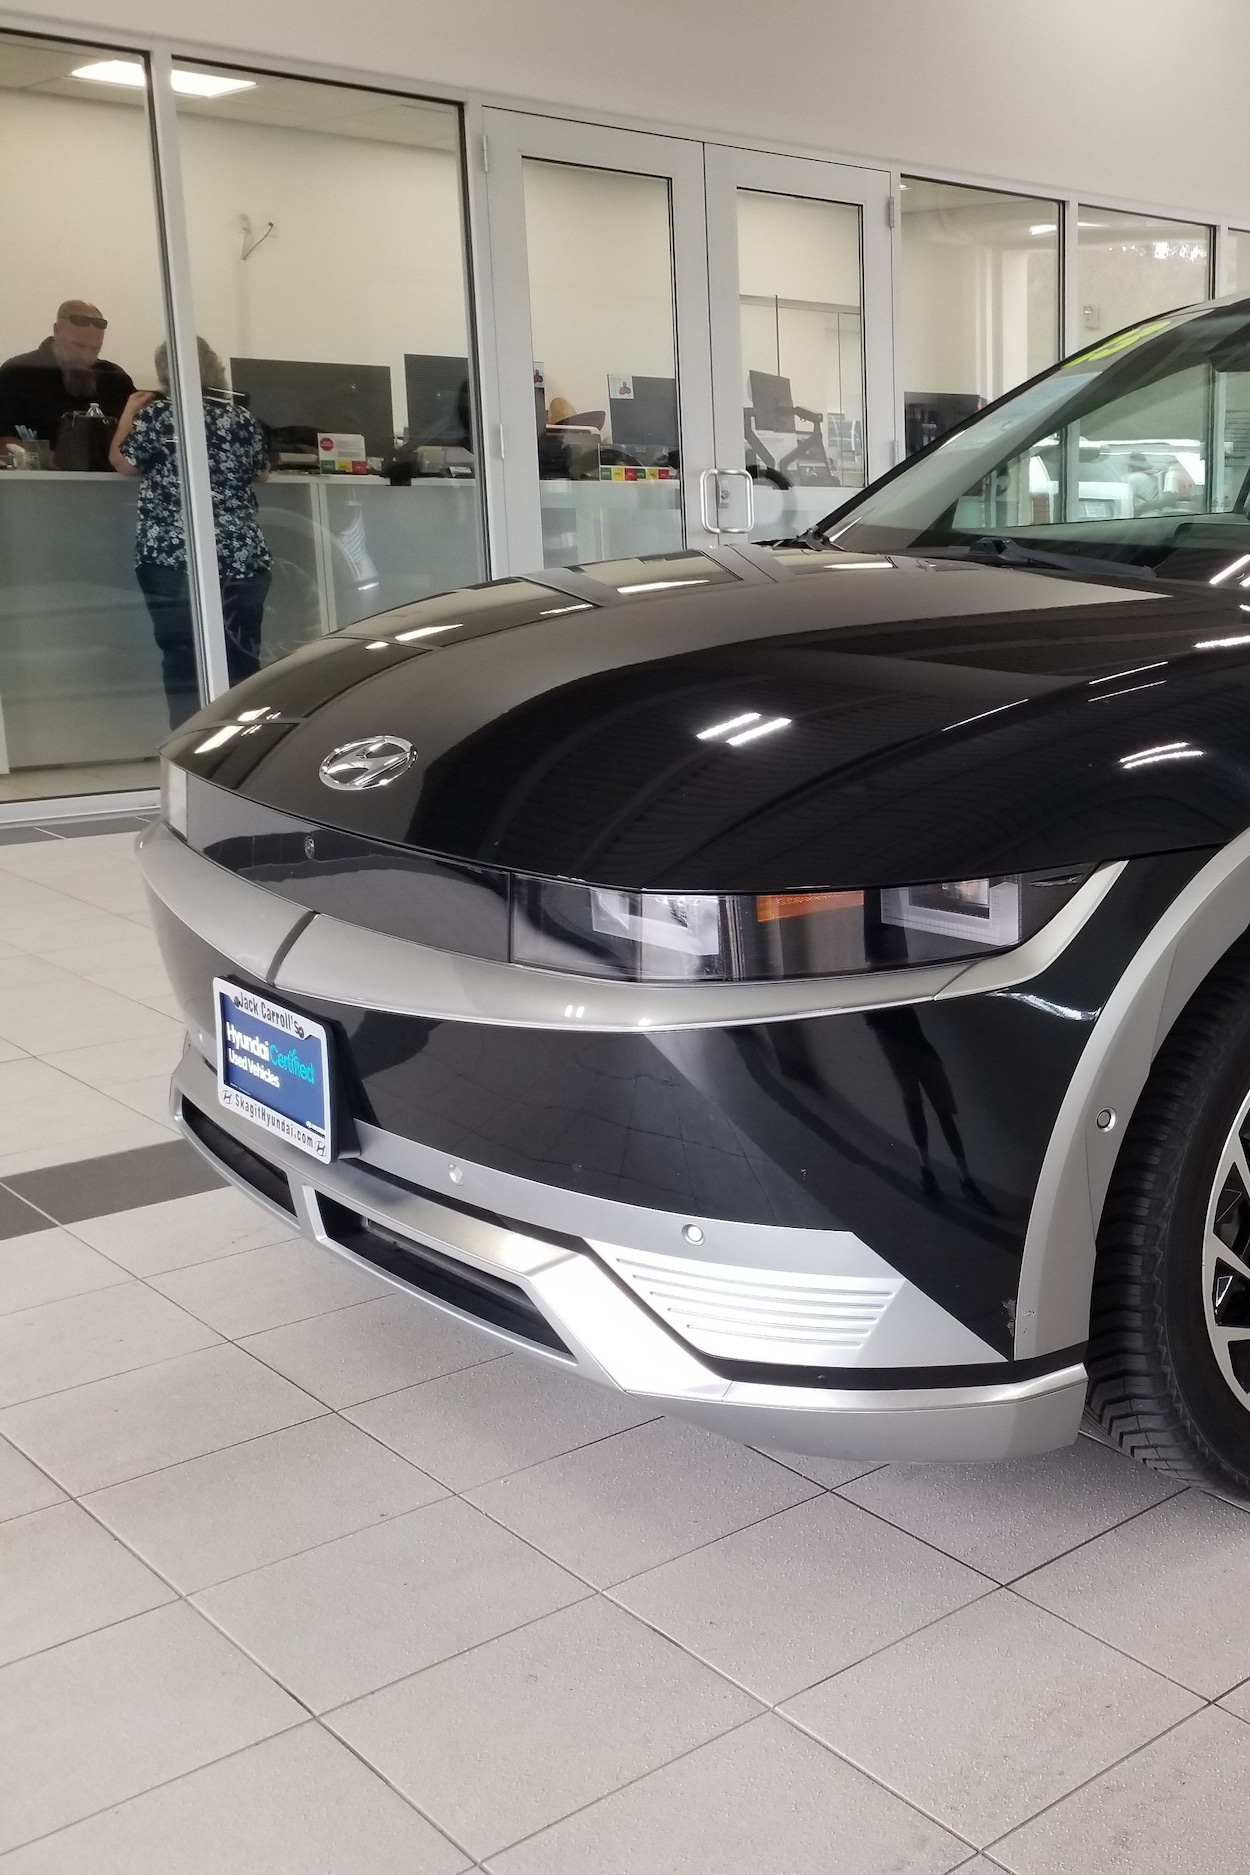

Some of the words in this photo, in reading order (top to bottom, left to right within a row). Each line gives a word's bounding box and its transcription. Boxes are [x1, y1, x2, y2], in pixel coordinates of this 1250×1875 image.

[239, 992, 259, 1016] Jack
[260, 1001, 299, 1034] Carroll's
[226, 1021, 270, 1062] Hyundai
[269, 1044, 315, 1084] Certified
[228, 1047, 248, 1071] Used
[247, 1057, 280, 1089] Vehicles
[235, 1094, 314, 1149] SkagitHyundai.com
